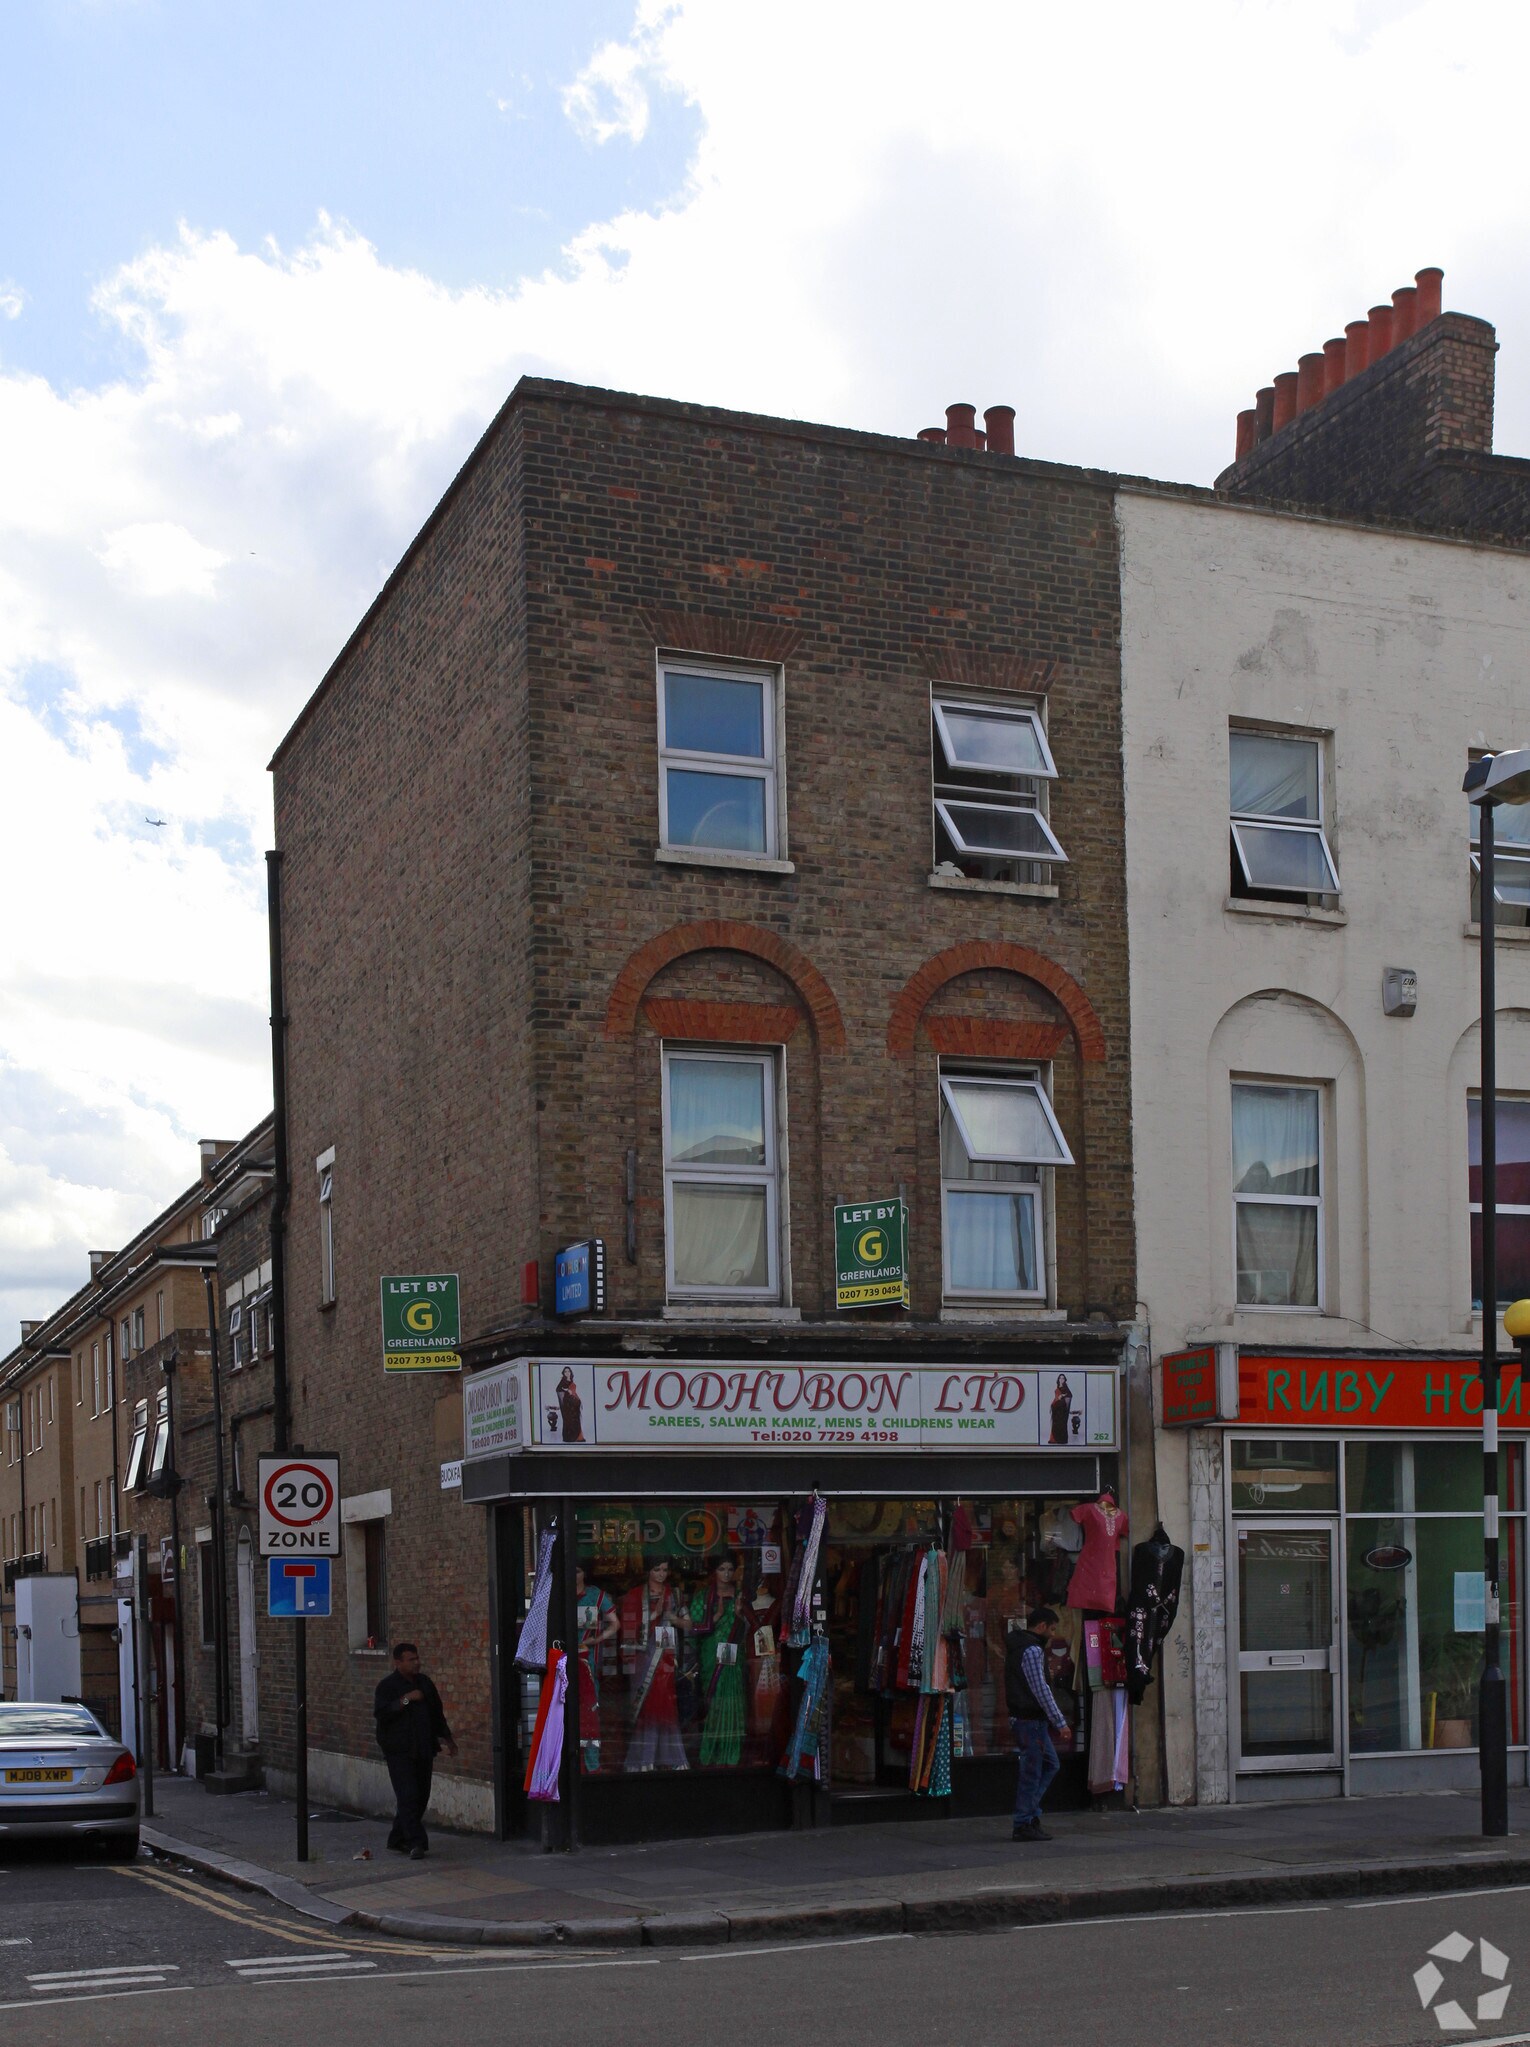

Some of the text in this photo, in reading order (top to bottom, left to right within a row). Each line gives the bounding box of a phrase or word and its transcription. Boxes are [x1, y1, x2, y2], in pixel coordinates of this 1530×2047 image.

[843, 1209, 871, 1223] LET
[877, 1206, 895, 1220] BY
[858, 1230, 882, 1262] G
[840, 1266, 901, 1281] GREENLANDS
[389, 1280, 449, 1294] LET BY
[562, 1282, 582, 1301] LIMITED
[839, 1285, 901, 1299] 0207 739 0494
[406, 1302, 433, 1331] G
[387, 1336, 457, 1348] GREENLANDS
[387, 1355, 458, 1365] 0207 739 0494
[1178, 1373, 1202, 1387] FOOD
[604, 1368, 1026, 1413] MODHUBON LTD
[1267, 1368, 1530, 1415] RUBY HOU
[649, 1416, 995, 1429] SAREES, SALWAR KAMIZ, MENS & CHILDRENS WEAR
[490, 1432, 503, 1445] 7729
[751, 1430, 899, 1442] Tel:020 7729 4198
[1093, 1433, 1110, 1441] 262
[276, 1482, 324, 1508] 20
[268, 1532, 331, 1548] ZONE
[10, 1769, 68, 1781] MJ08 XWP
